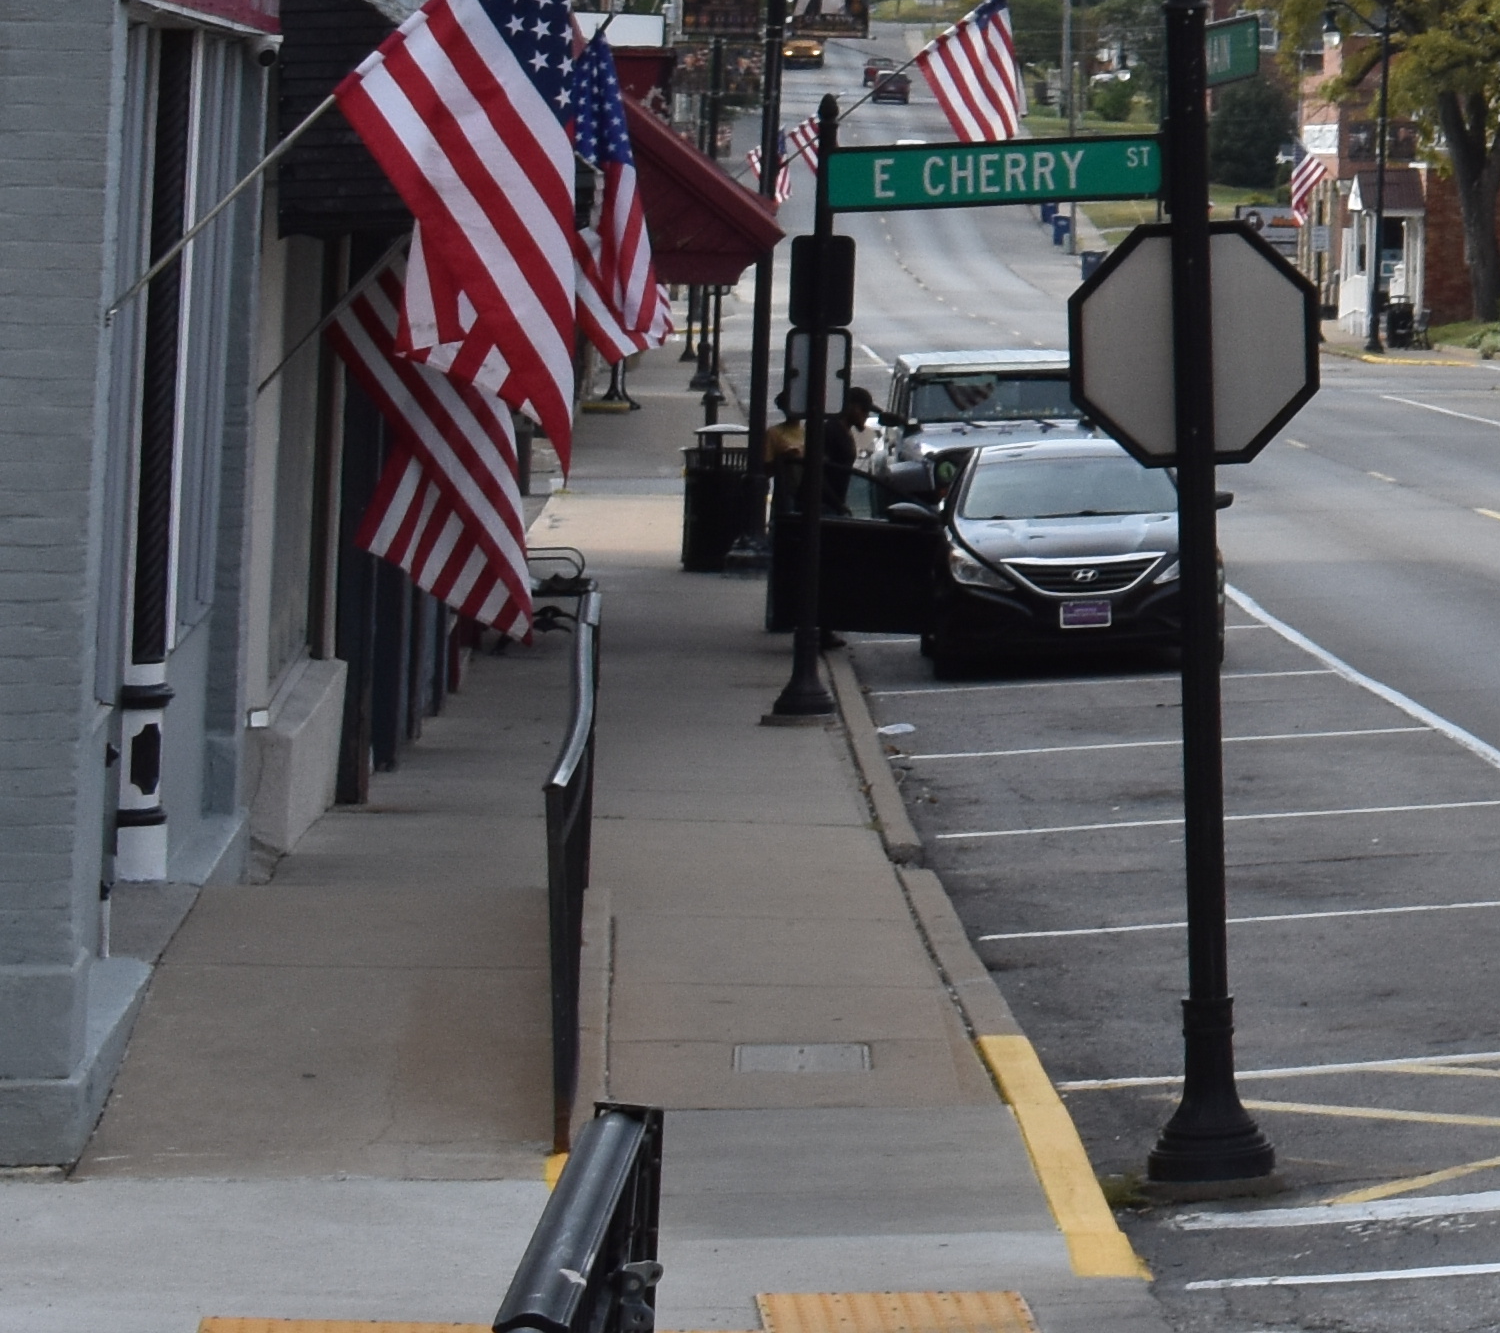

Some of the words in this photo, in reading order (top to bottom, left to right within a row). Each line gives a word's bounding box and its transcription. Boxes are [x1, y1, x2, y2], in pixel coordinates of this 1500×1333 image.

[872, 158, 895, 199] E
[923, 149, 1085, 196] CHERRY
[1126, 146, 1151, 168] ST
